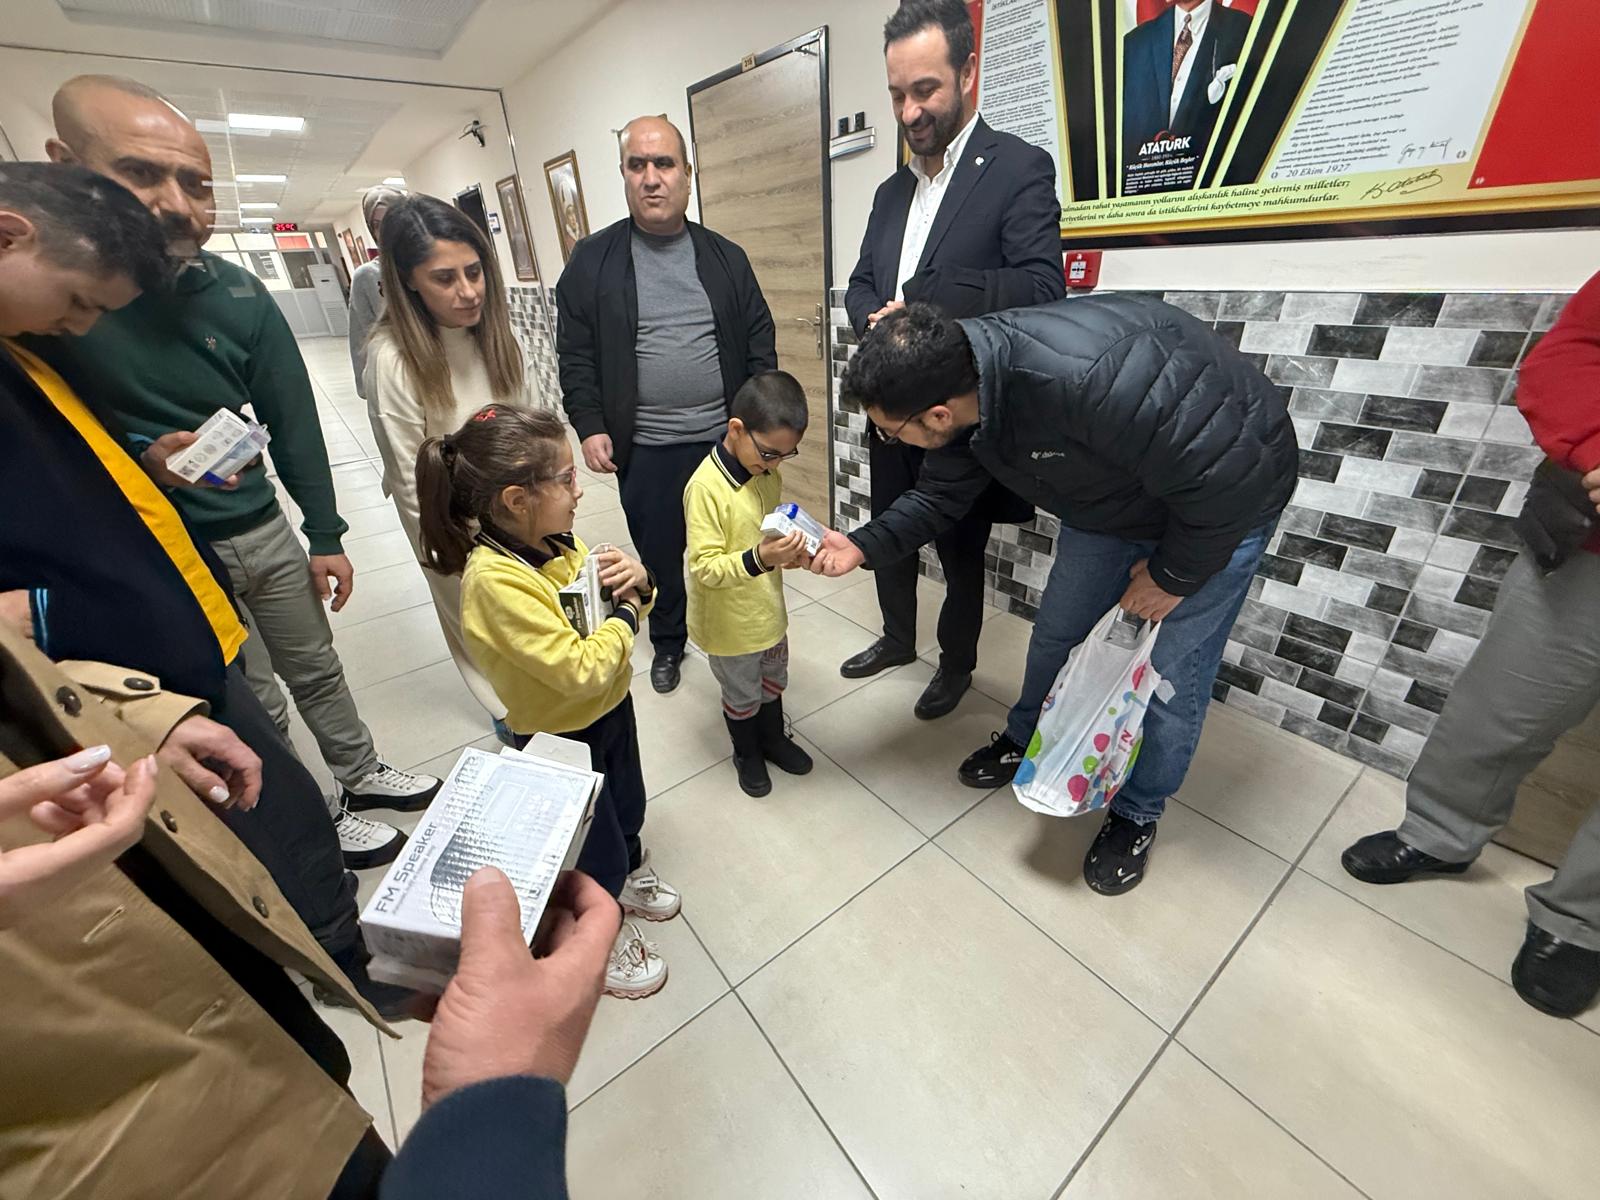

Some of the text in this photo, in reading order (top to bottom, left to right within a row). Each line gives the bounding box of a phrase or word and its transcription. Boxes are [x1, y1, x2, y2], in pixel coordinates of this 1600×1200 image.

[1286, 163, 1351, 178] 20 Ekim 1927
[1230, 187, 1260, 198] haline
[1259, 183, 1302, 198] getirmiş
[1303, 178, 1351, 191] milletler;
[1106, 209, 1124, 219] daha
[1146, 207, 1157, 216] da
[375, 884, 402, 913] FM
[393, 821, 439, 884] Speaker
